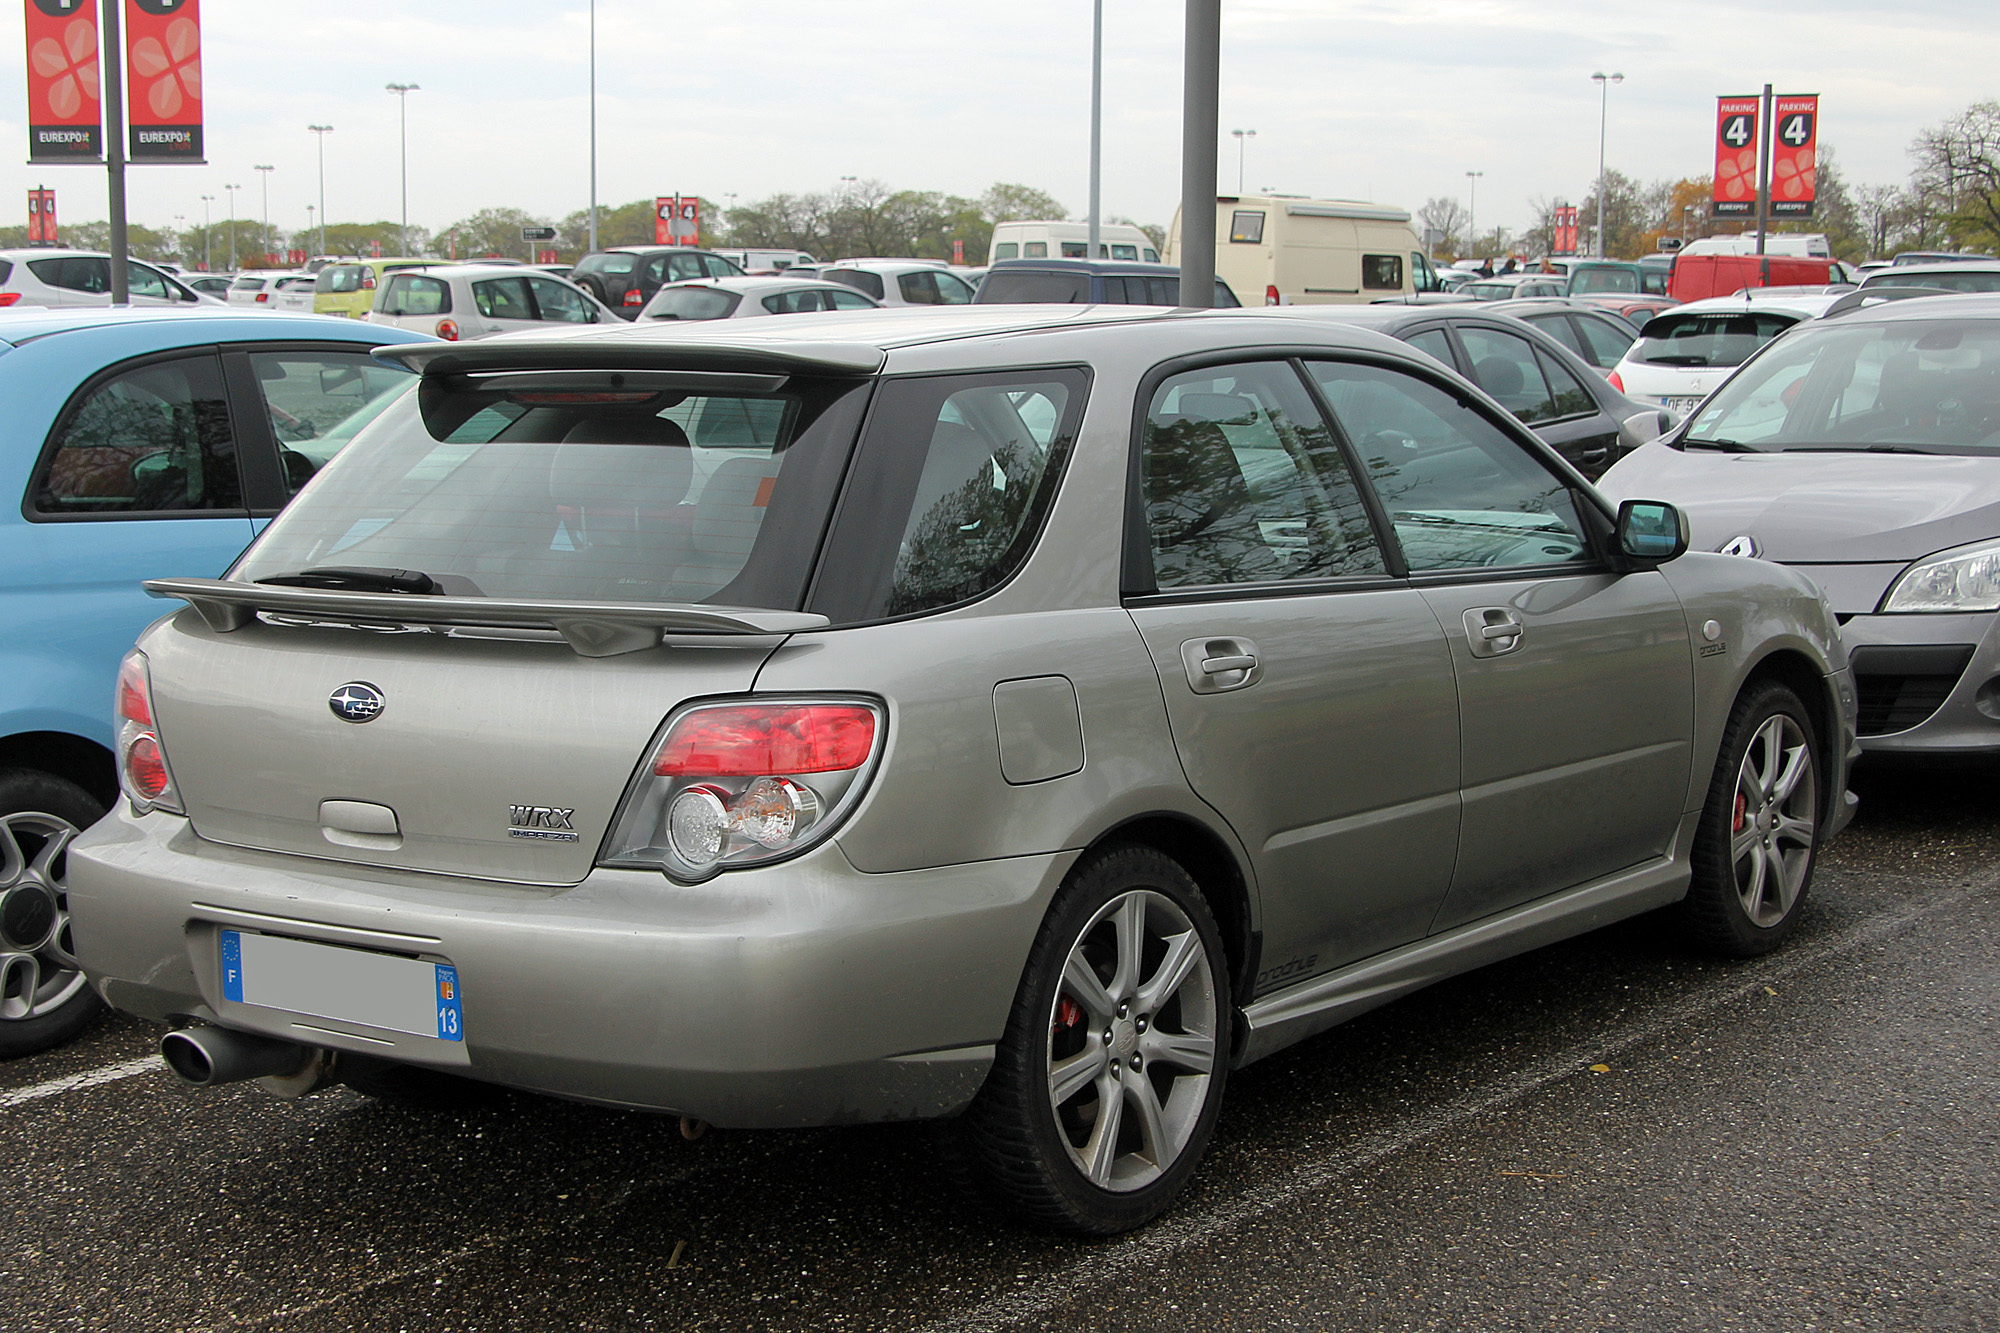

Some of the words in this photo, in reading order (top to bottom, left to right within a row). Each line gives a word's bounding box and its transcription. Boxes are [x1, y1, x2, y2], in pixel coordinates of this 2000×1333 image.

[1720, 104, 1756, 113] PARKING
[1779, 102, 1815, 112] PARKING
[39, 131, 82, 143] EUREXPO
[139, 131, 183, 143] EUREXPO
[1726, 116, 1748, 146] 4
[1784, 115, 1806, 145] 4
[30, 199, 38, 215] 4
[45, 199, 54, 214] 4
[659, 205, 671, 220] 4
[683, 205, 695, 220] 4
[509, 804, 575, 829] WRX
[228, 969, 237, 983] F
[438, 974, 455, 983] PACA
[439, 1007, 458, 1034] 13
